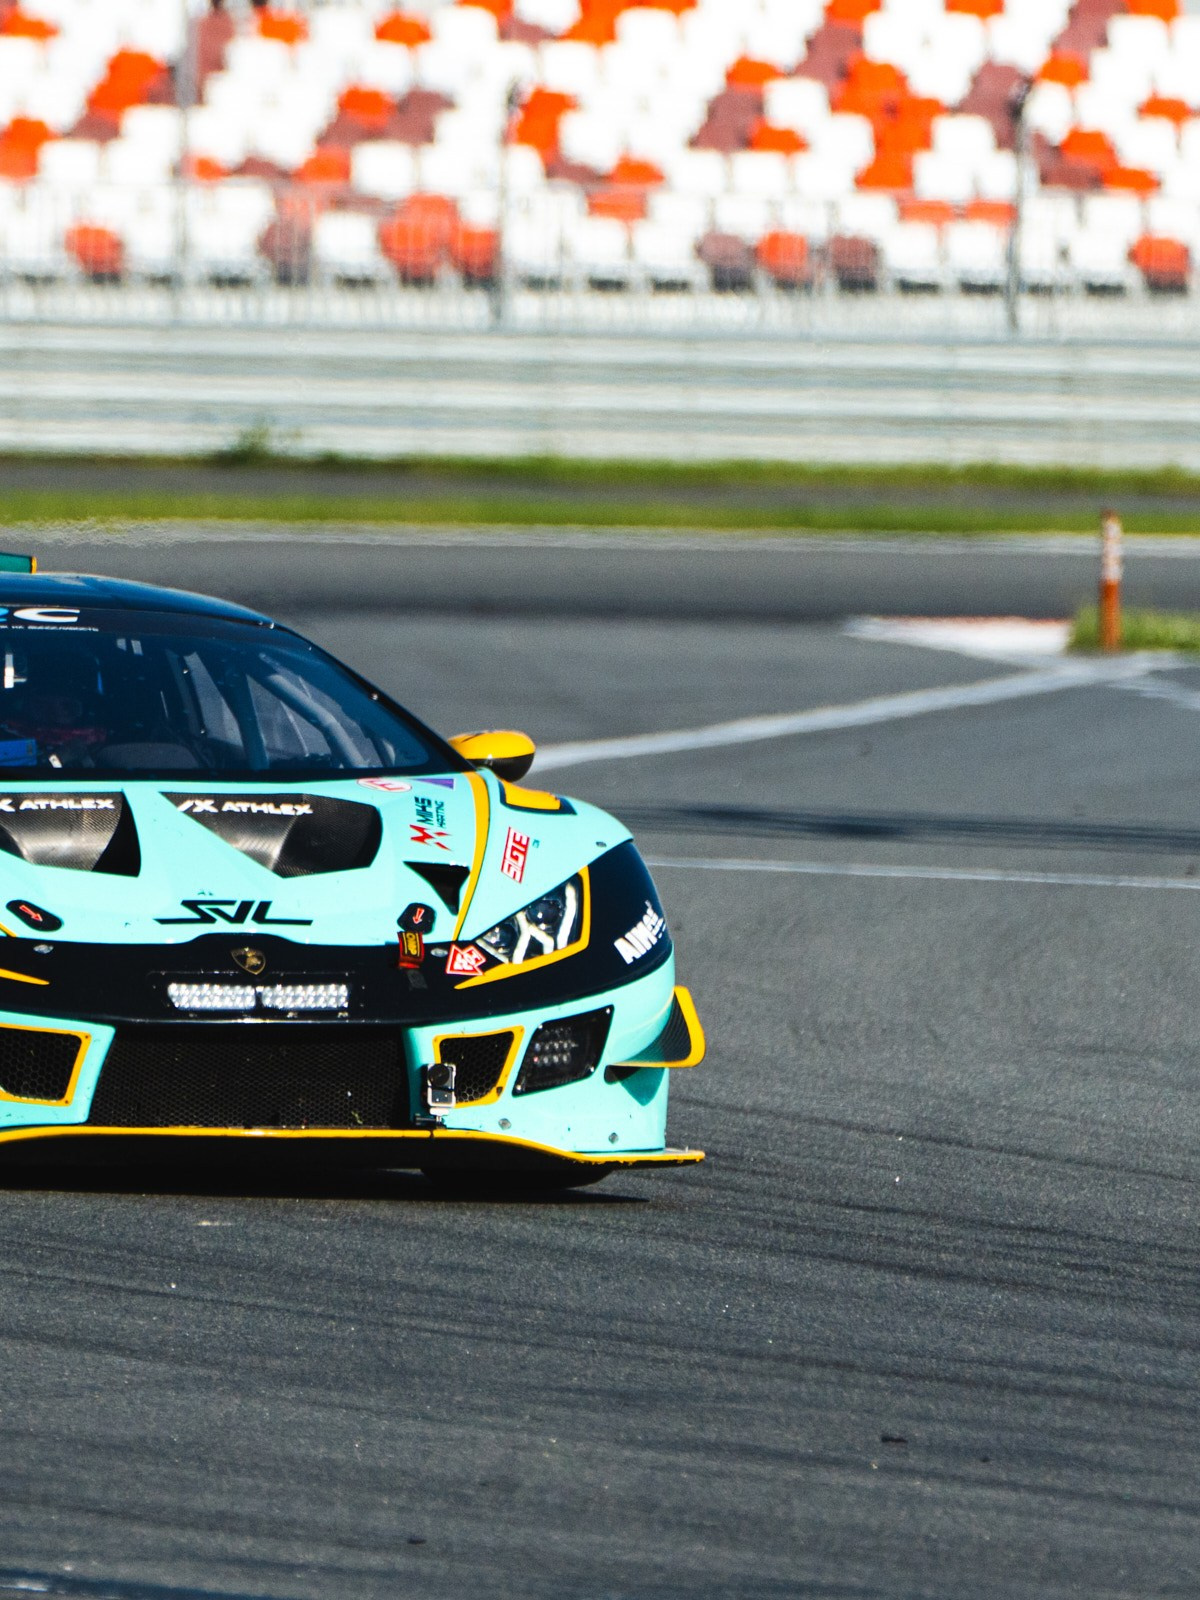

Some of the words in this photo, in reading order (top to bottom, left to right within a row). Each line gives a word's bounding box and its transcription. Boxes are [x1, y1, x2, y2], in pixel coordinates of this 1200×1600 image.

[19, 798, 115, 810] ATHLEX
[221, 801, 314, 816] ATHLEX
[153, 899, 314, 926] SVL
